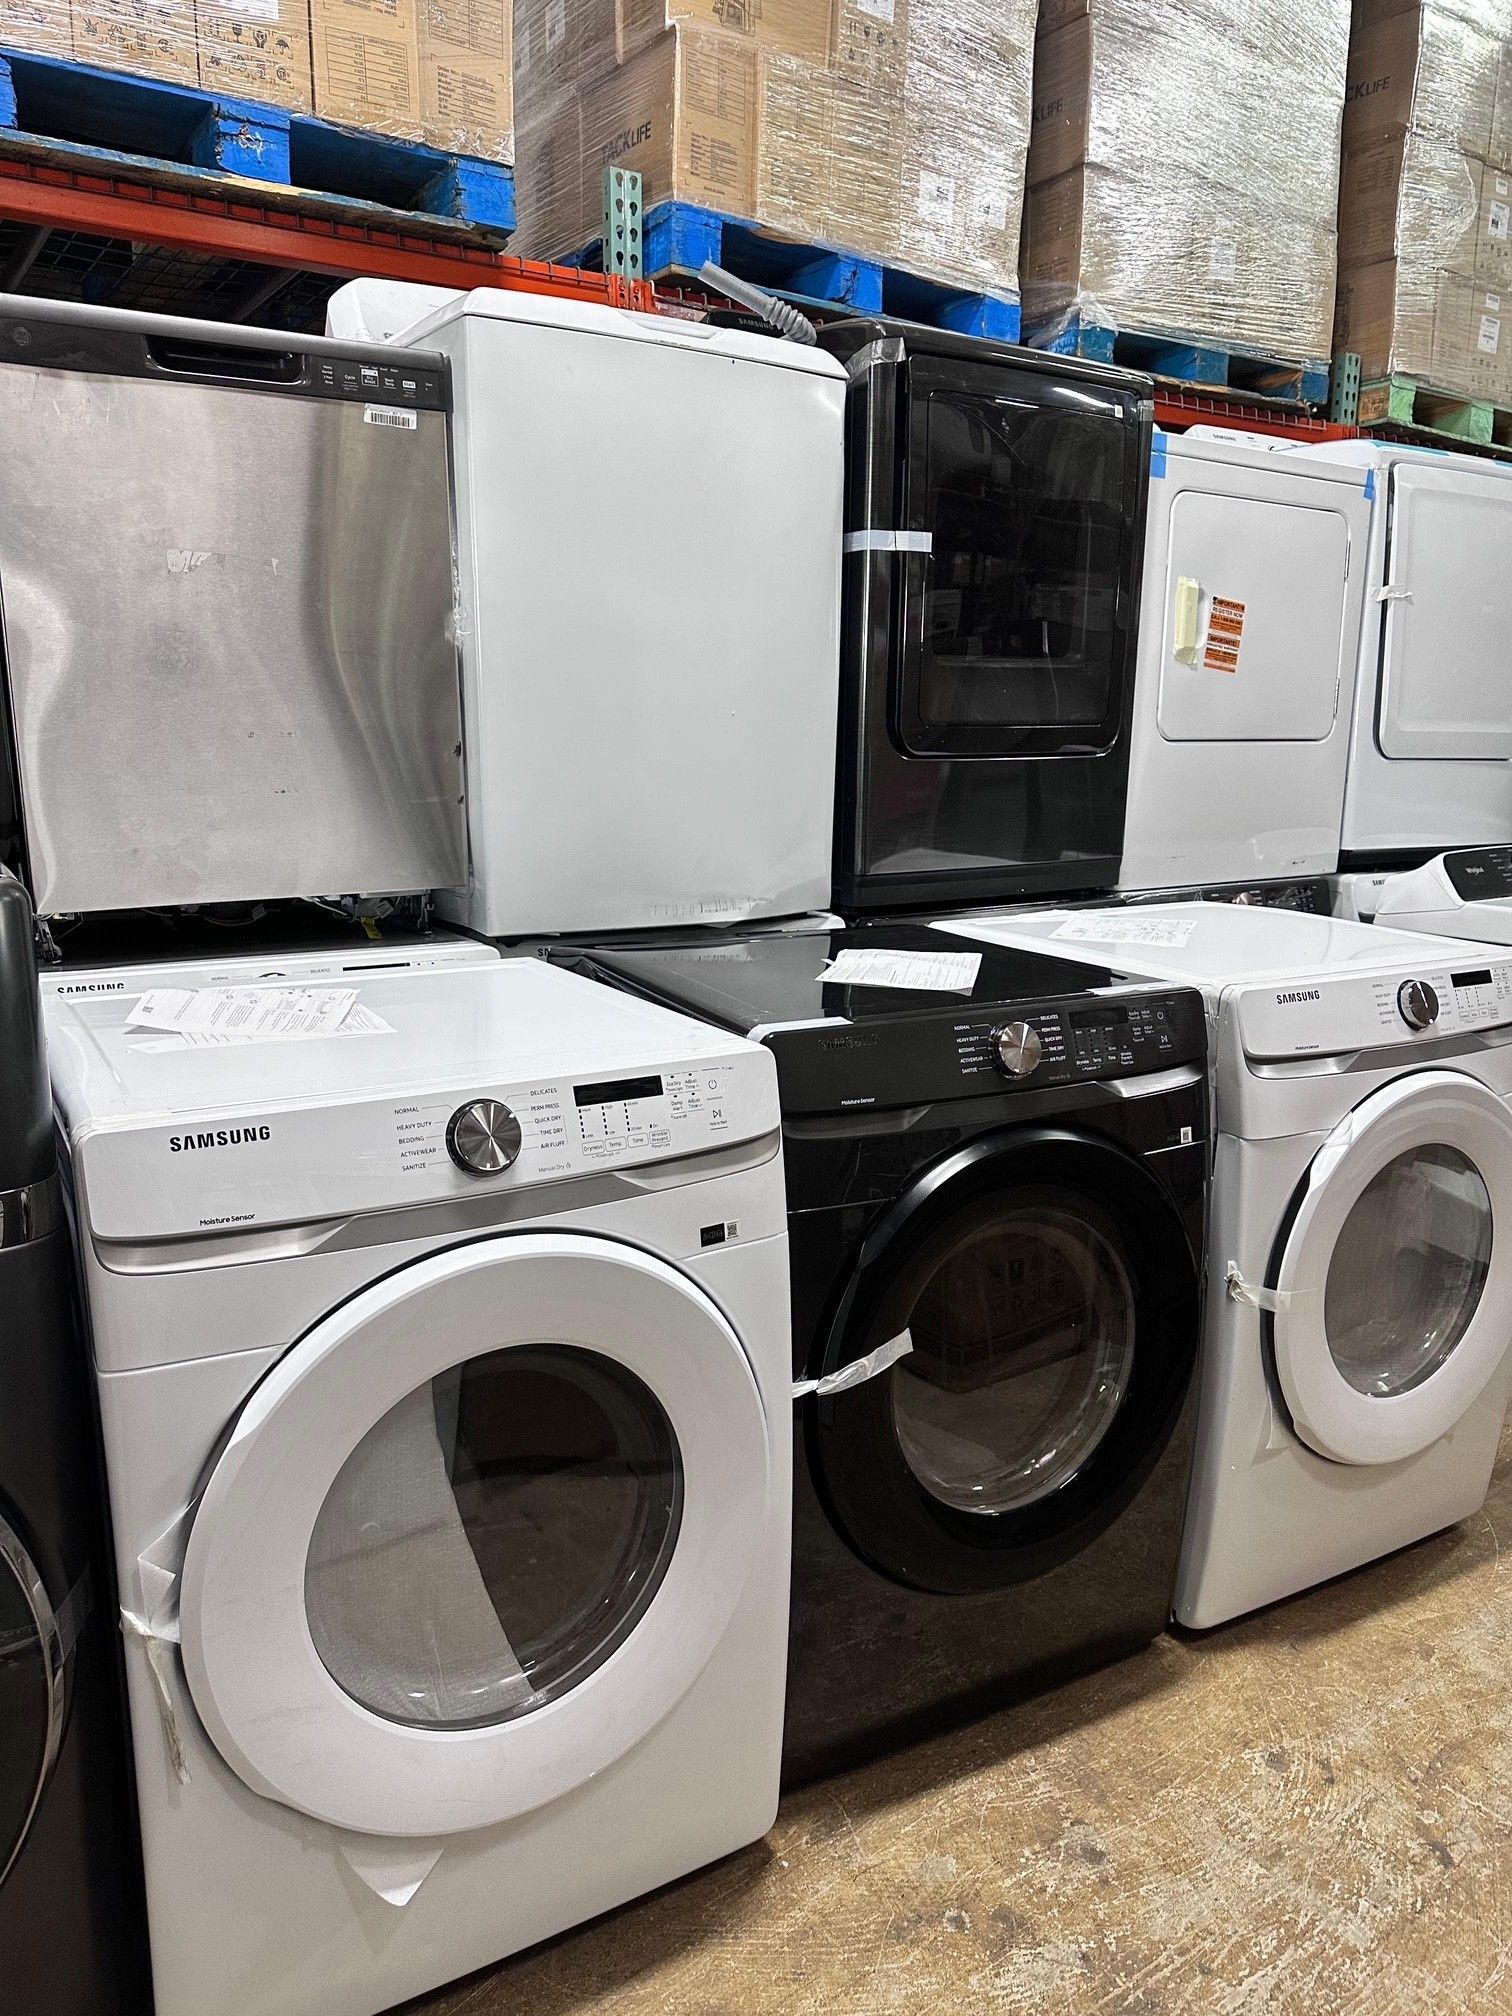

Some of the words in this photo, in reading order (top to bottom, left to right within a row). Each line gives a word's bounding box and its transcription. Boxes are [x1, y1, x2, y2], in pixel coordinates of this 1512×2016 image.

[600, 121, 652, 166] TACKLIFE
[738, 318, 774, 329] SAMSUNG
[1212, 433, 1237, 442] SAMSUNG
[1213, 606, 1233, 616] REGISTER
[1276, 990, 1320, 1004] SAMSUNG
[960, 1055, 984, 1064] ACTIVEWEAR
[961, 1066, 978, 1074] SANITIZE
[530, 1087, 558, 1097] DELICATES
[394, 1106, 420, 1115] NORMAL
[534, 1116, 550, 1124] QUICK
[397, 1123, 418, 1132] HEAVY
[417, 1120, 432, 1129] DUTY
[540, 1128, 552, 1136] TIME
[169, 1125, 271, 1153] SAMSUNG
[398, 1135, 425, 1145] BEDDING
[540, 1142, 550, 1150] AIR
[549, 1140, 566, 1148] FLUFF
[583, 1143, 604, 1153] Dryness
[608, 1140, 623, 1148] Temp.
[632, 1137, 644, 1145] Time
[400, 1147, 437, 1159] ACTIVEWEAR
[401, 1161, 427, 1173] SANITIZE
[538, 1164, 556, 1173] Manual
[555, 1162, 566, 1171] Dry
[199, 1217, 231, 1227] Moisture
[231, 1213, 256, 1222] Sensor
